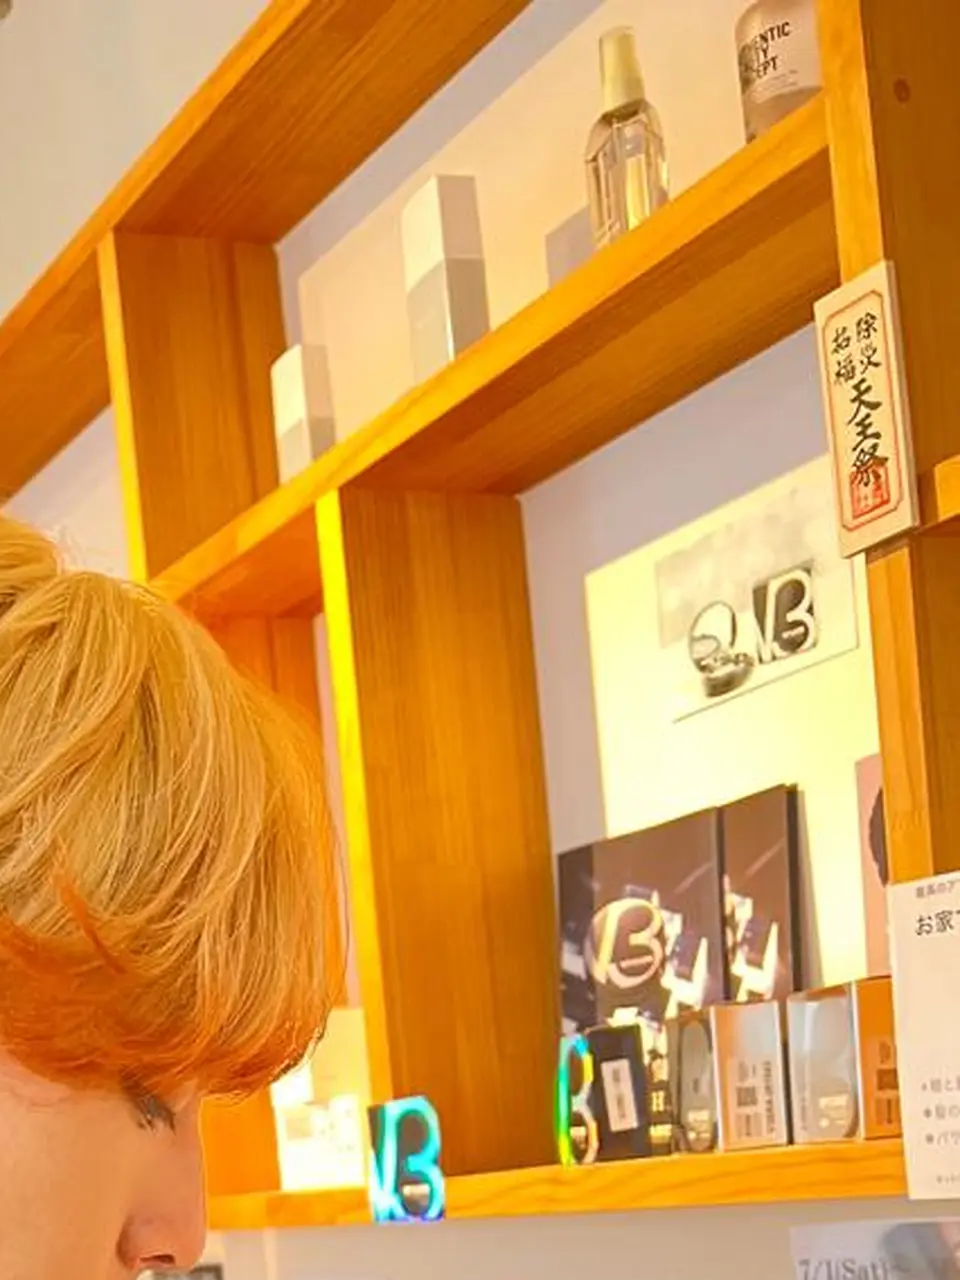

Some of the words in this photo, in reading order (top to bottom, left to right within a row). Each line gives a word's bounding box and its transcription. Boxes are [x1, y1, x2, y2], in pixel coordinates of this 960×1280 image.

[847, 376, 889, 487] 天王祭
[914, 909, 960, 936] お家
